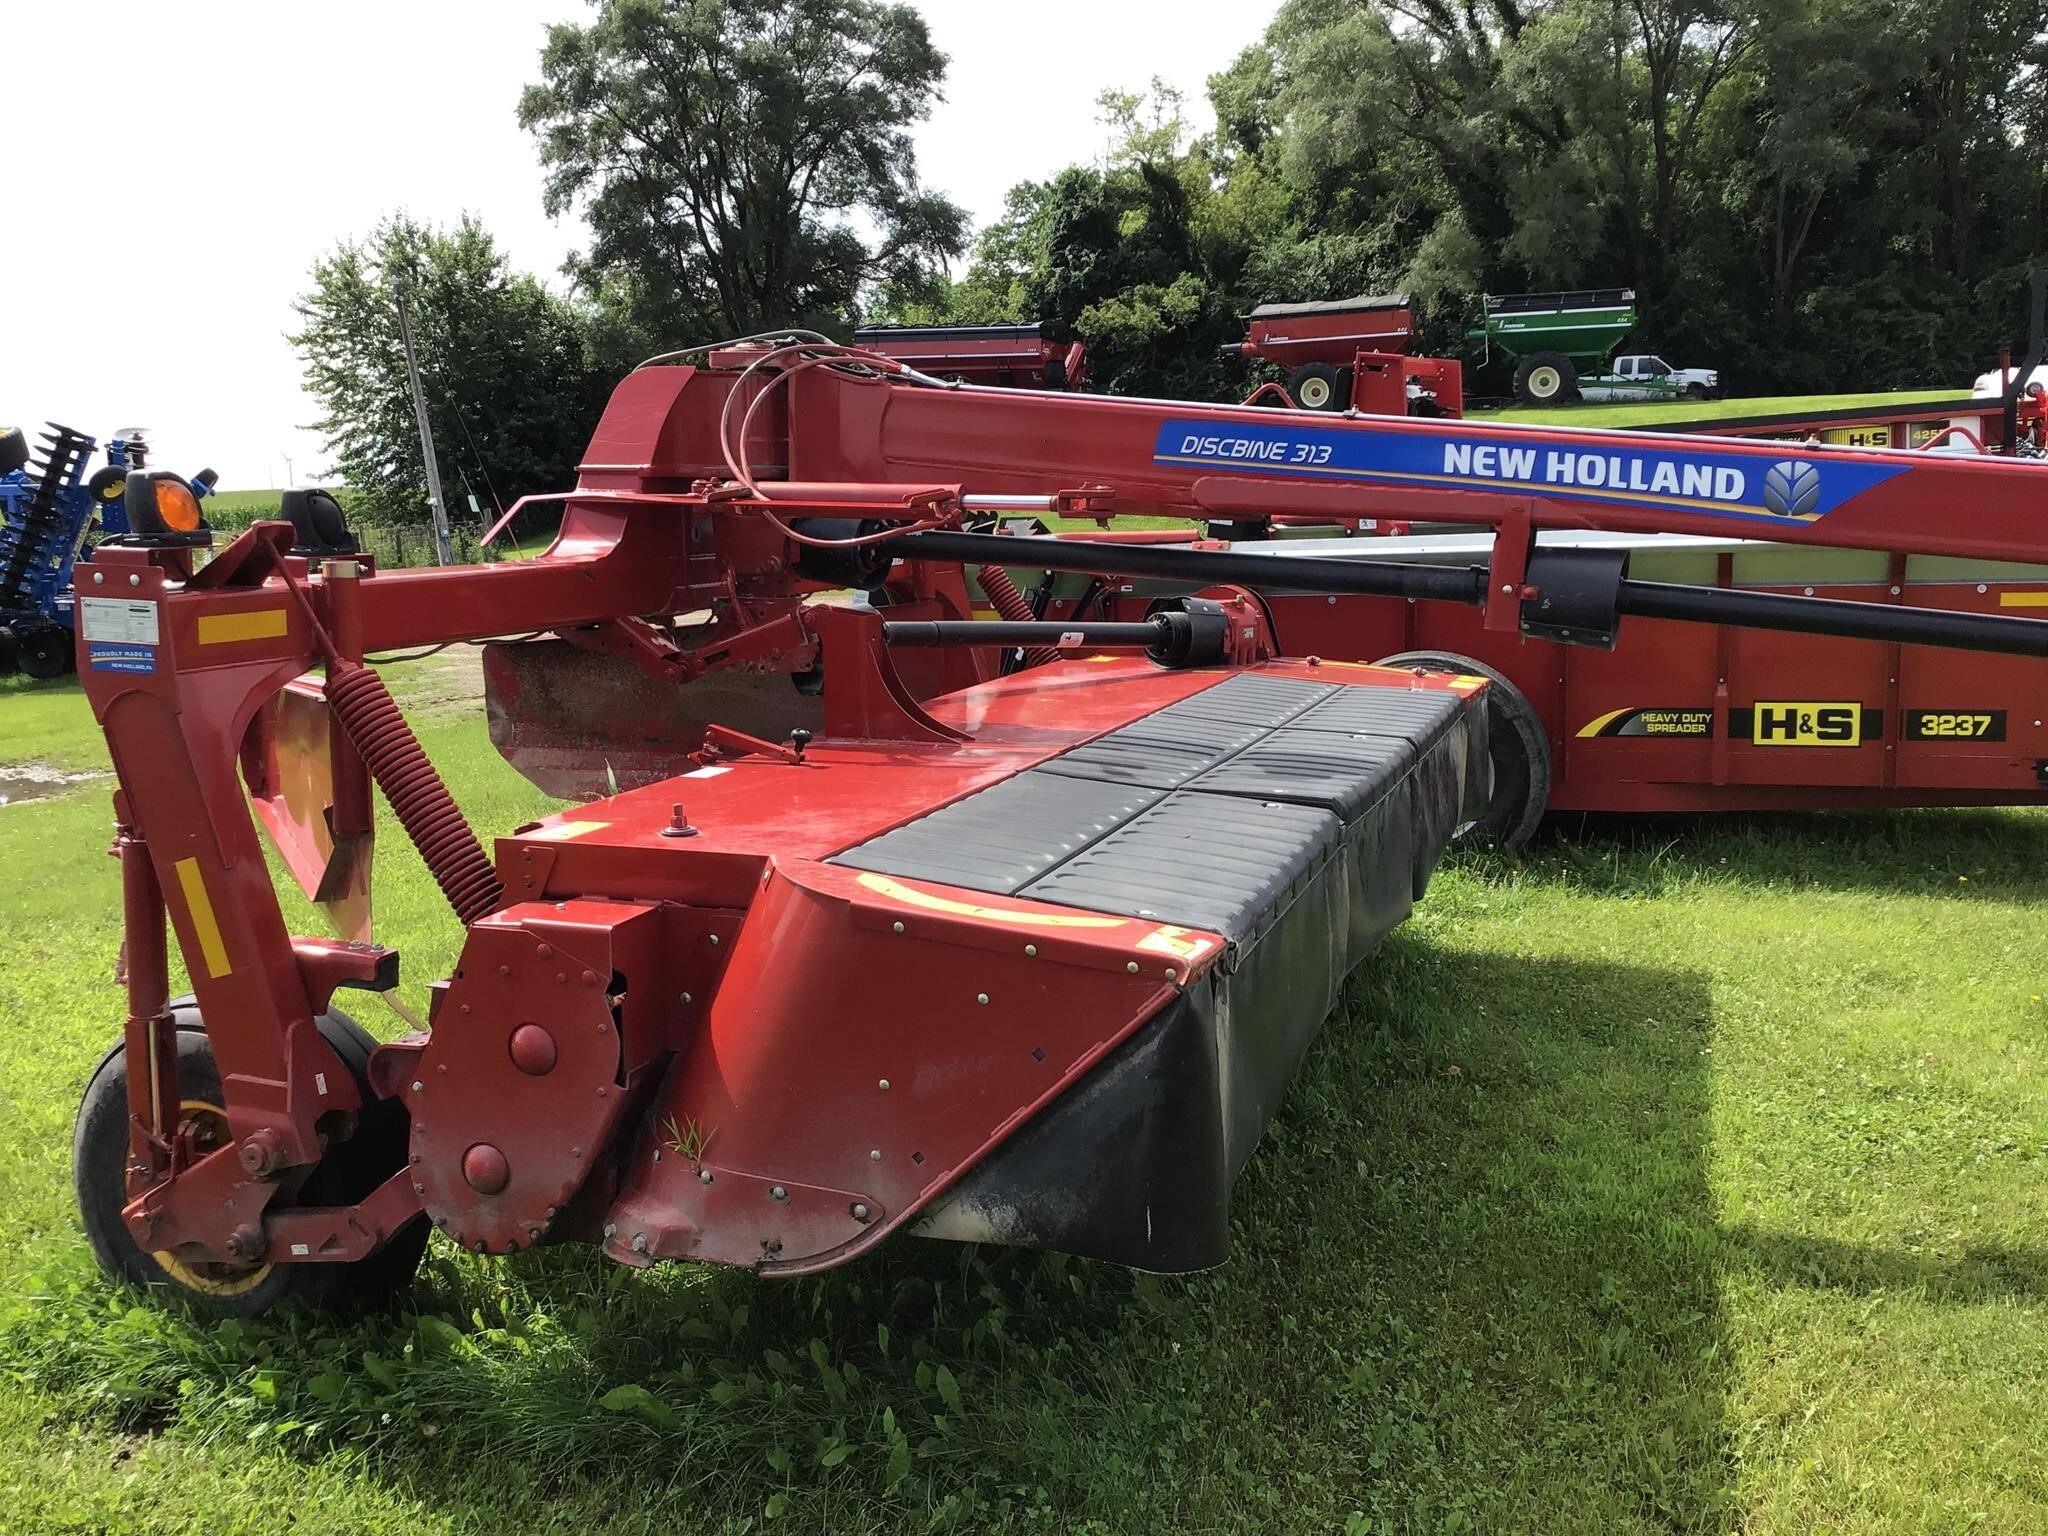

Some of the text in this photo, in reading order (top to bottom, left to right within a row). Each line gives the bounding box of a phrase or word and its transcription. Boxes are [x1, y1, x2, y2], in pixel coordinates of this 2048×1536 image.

[1850, 431, 1887, 446] H&S
[1180, 435, 1334, 465] DISCBINE 313
[1443, 443, 1746, 501] NEW HOLLAND
[1641, 712, 1713, 723] HEAVY DUTY
[1646, 723, 1707, 734] SPREADER
[1760, 707, 1854, 740] H&S
[1921, 714, 1992, 736] 3237
